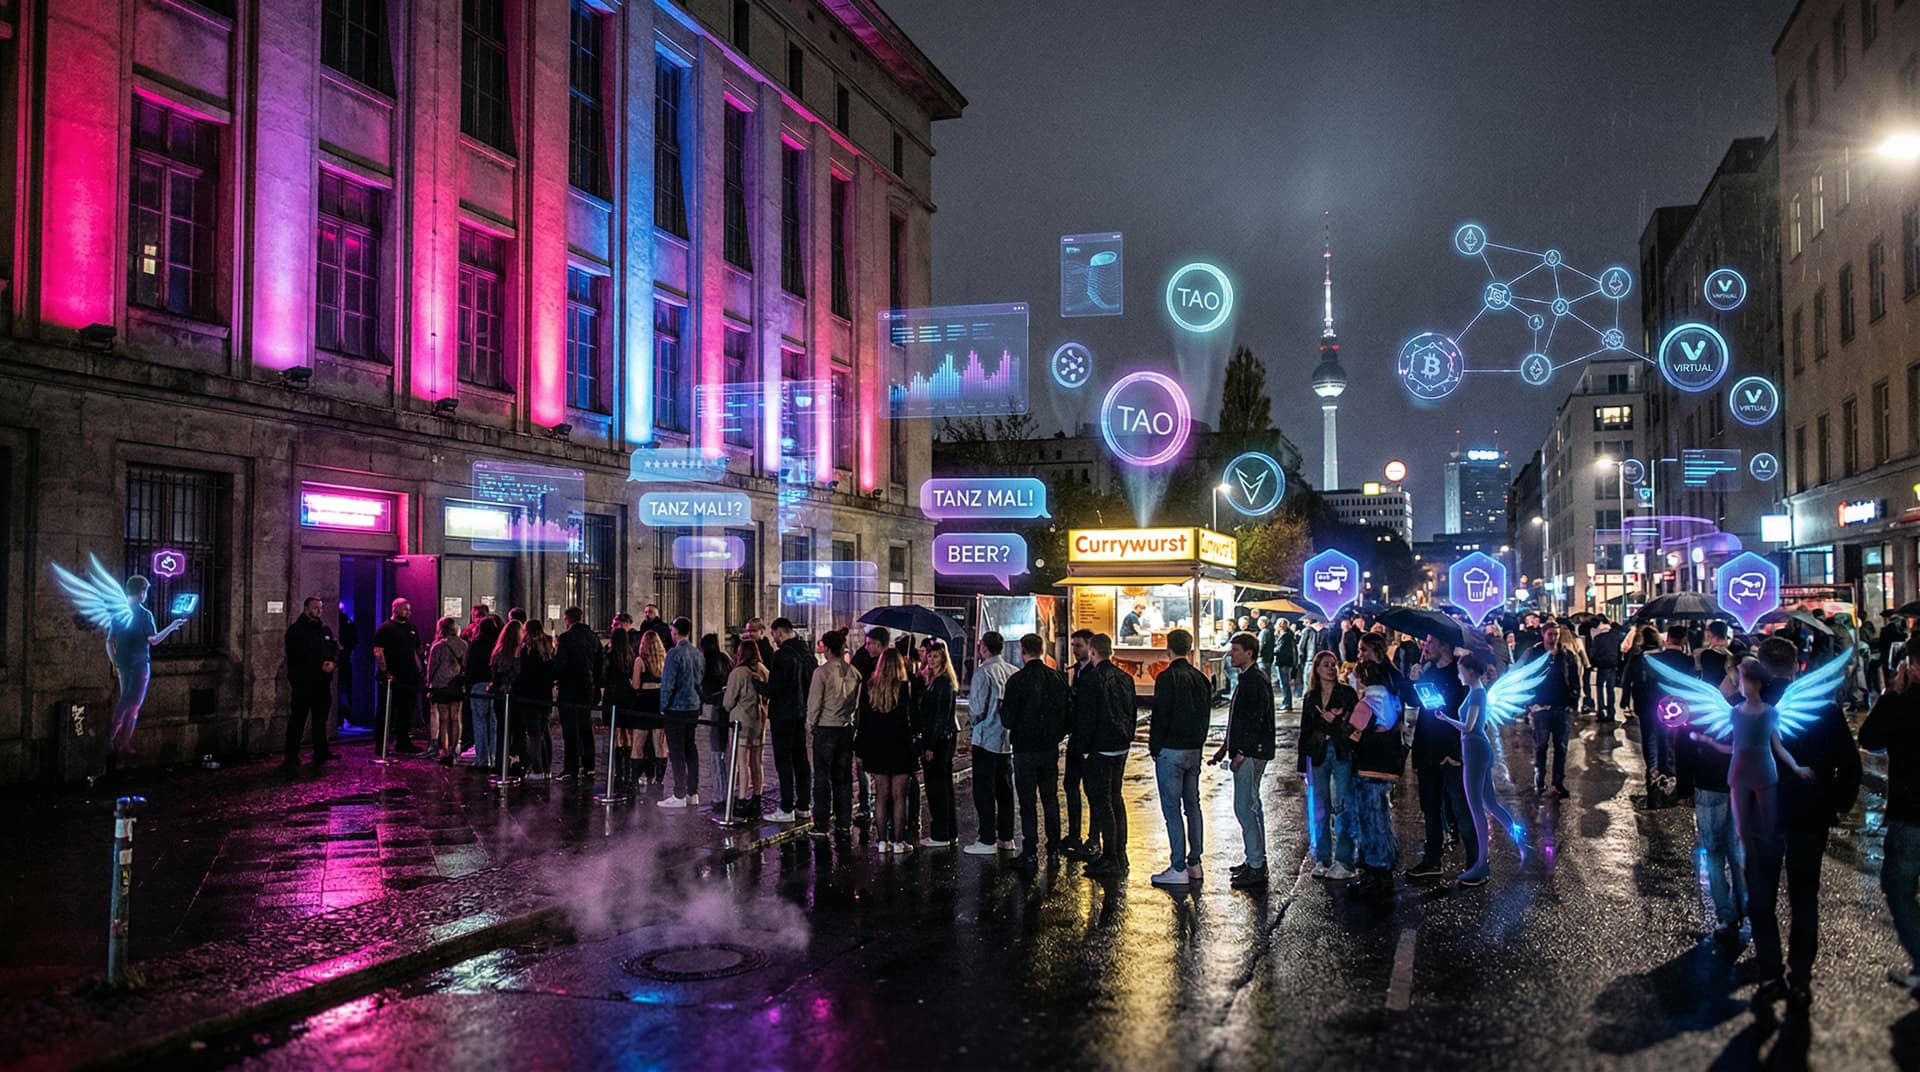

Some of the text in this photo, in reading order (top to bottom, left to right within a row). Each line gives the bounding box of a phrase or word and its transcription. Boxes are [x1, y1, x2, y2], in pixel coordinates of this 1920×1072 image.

[1177, 288, 1220, 309] TAO
[1673, 363, 1714, 373] VIRTUAL
[1117, 405, 1174, 436] TAO
[933, 490, 1034, 507] TANZ MAL!
[649, 502, 744, 517] TANZ MAL!?
[947, 545, 1011, 564] BEER?
[1074, 534, 1188, 558] Currywurst
